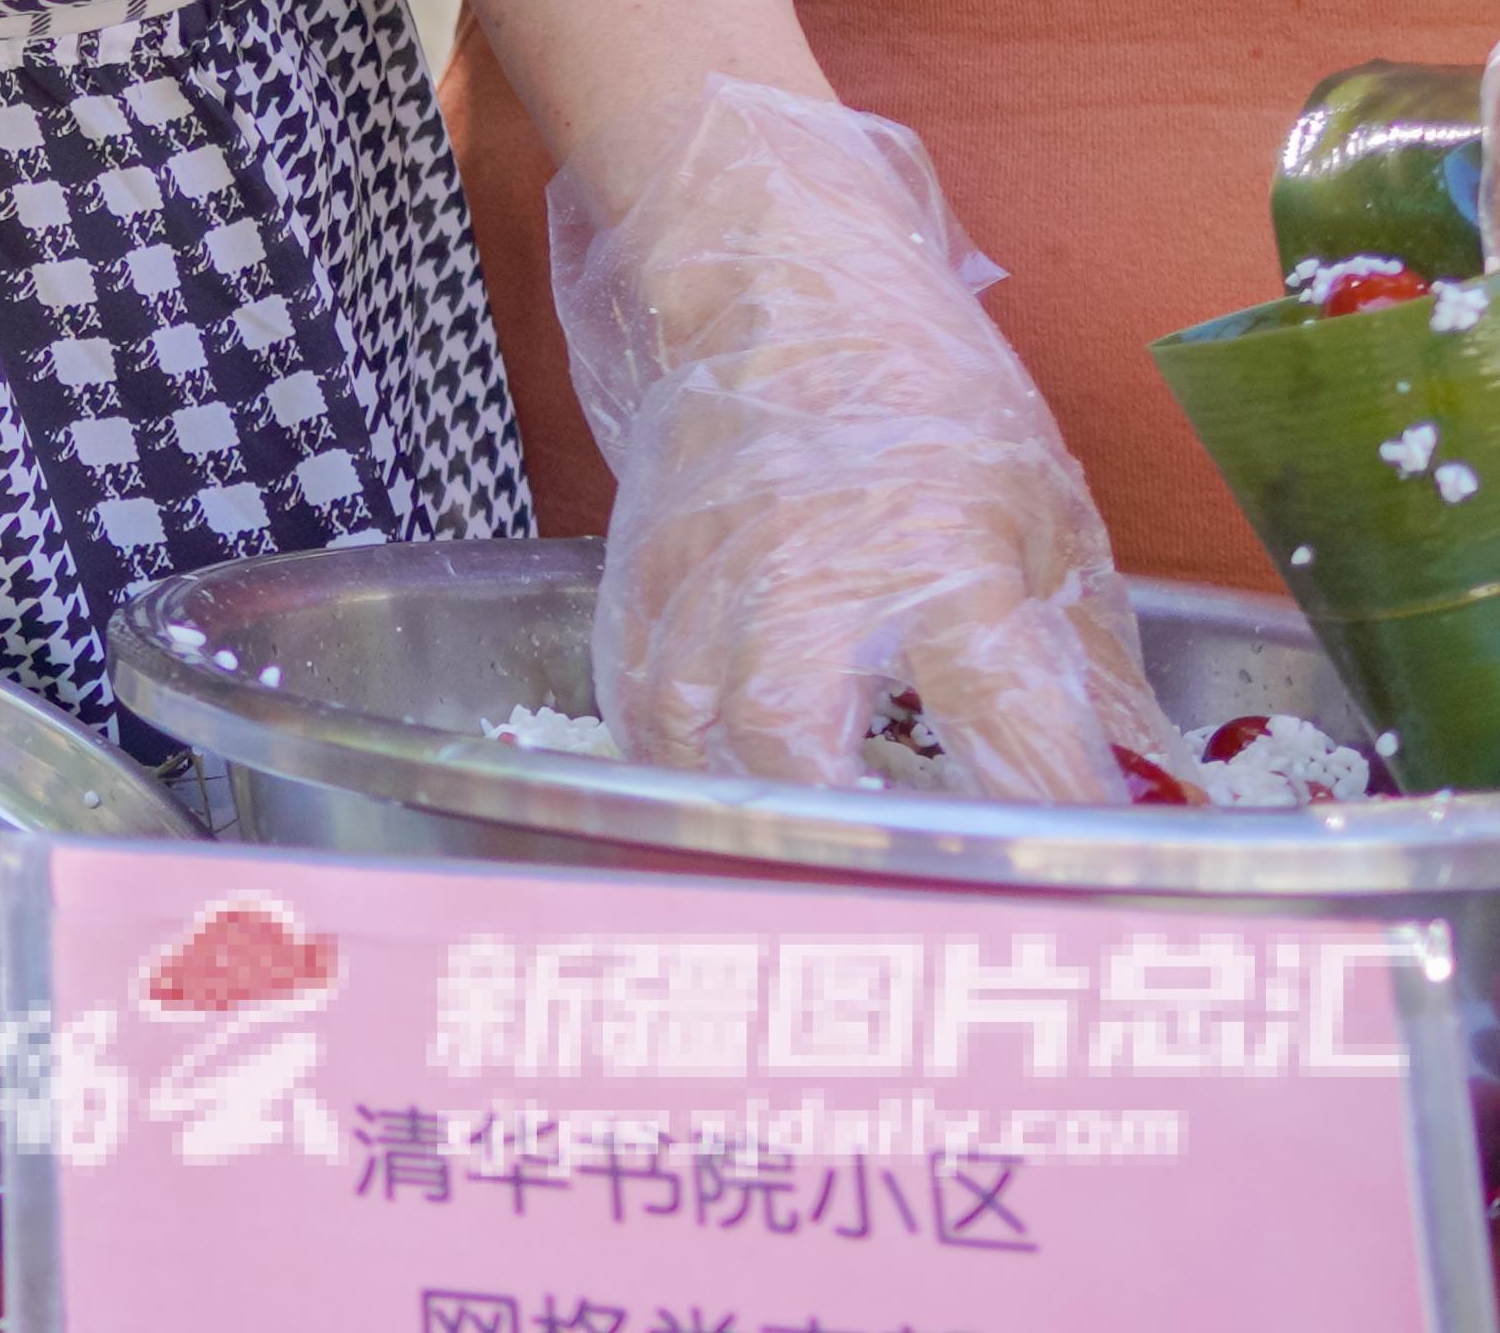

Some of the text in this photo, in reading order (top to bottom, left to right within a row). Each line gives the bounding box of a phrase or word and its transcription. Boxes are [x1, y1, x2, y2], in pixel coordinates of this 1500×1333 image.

[351, 1102, 1039, 1253] 清华书院小区
